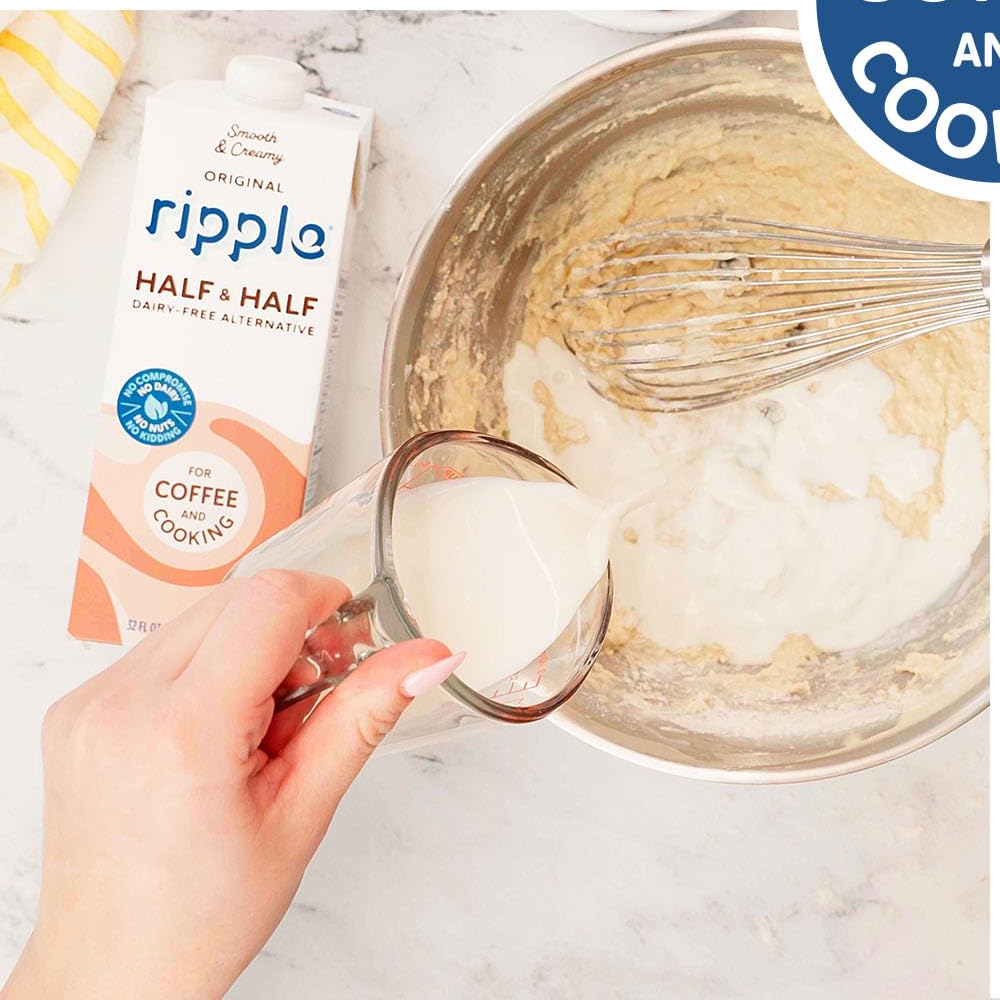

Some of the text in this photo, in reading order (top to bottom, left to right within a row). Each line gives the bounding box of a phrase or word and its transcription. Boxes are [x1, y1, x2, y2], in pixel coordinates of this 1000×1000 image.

[227, 124, 278, 144] Smooth
[215, 140, 285, 165] & Creamy
[204, 170, 284, 193] ORIGINAL
[145, 189, 325, 262] ripple
[135, 270, 214, 301] HALF
[219, 288, 230, 301] &
[239, 286, 318, 317] HALF
[132, 299, 315, 336] DAIRY-FREE ALTERNATIVE
[123, 372, 192, 407] NO COMPROMISE
[137, 382, 181, 401] NO DAIRY
[125, 420, 182, 443] NO KIDDING
[133, 414, 175, 433] NO NUTS
[188, 466, 211, 478] FOR
[155, 480, 239, 508] COFFEE
[153, 508, 234, 545] COOKING
[181, 510, 206, 522] AND
